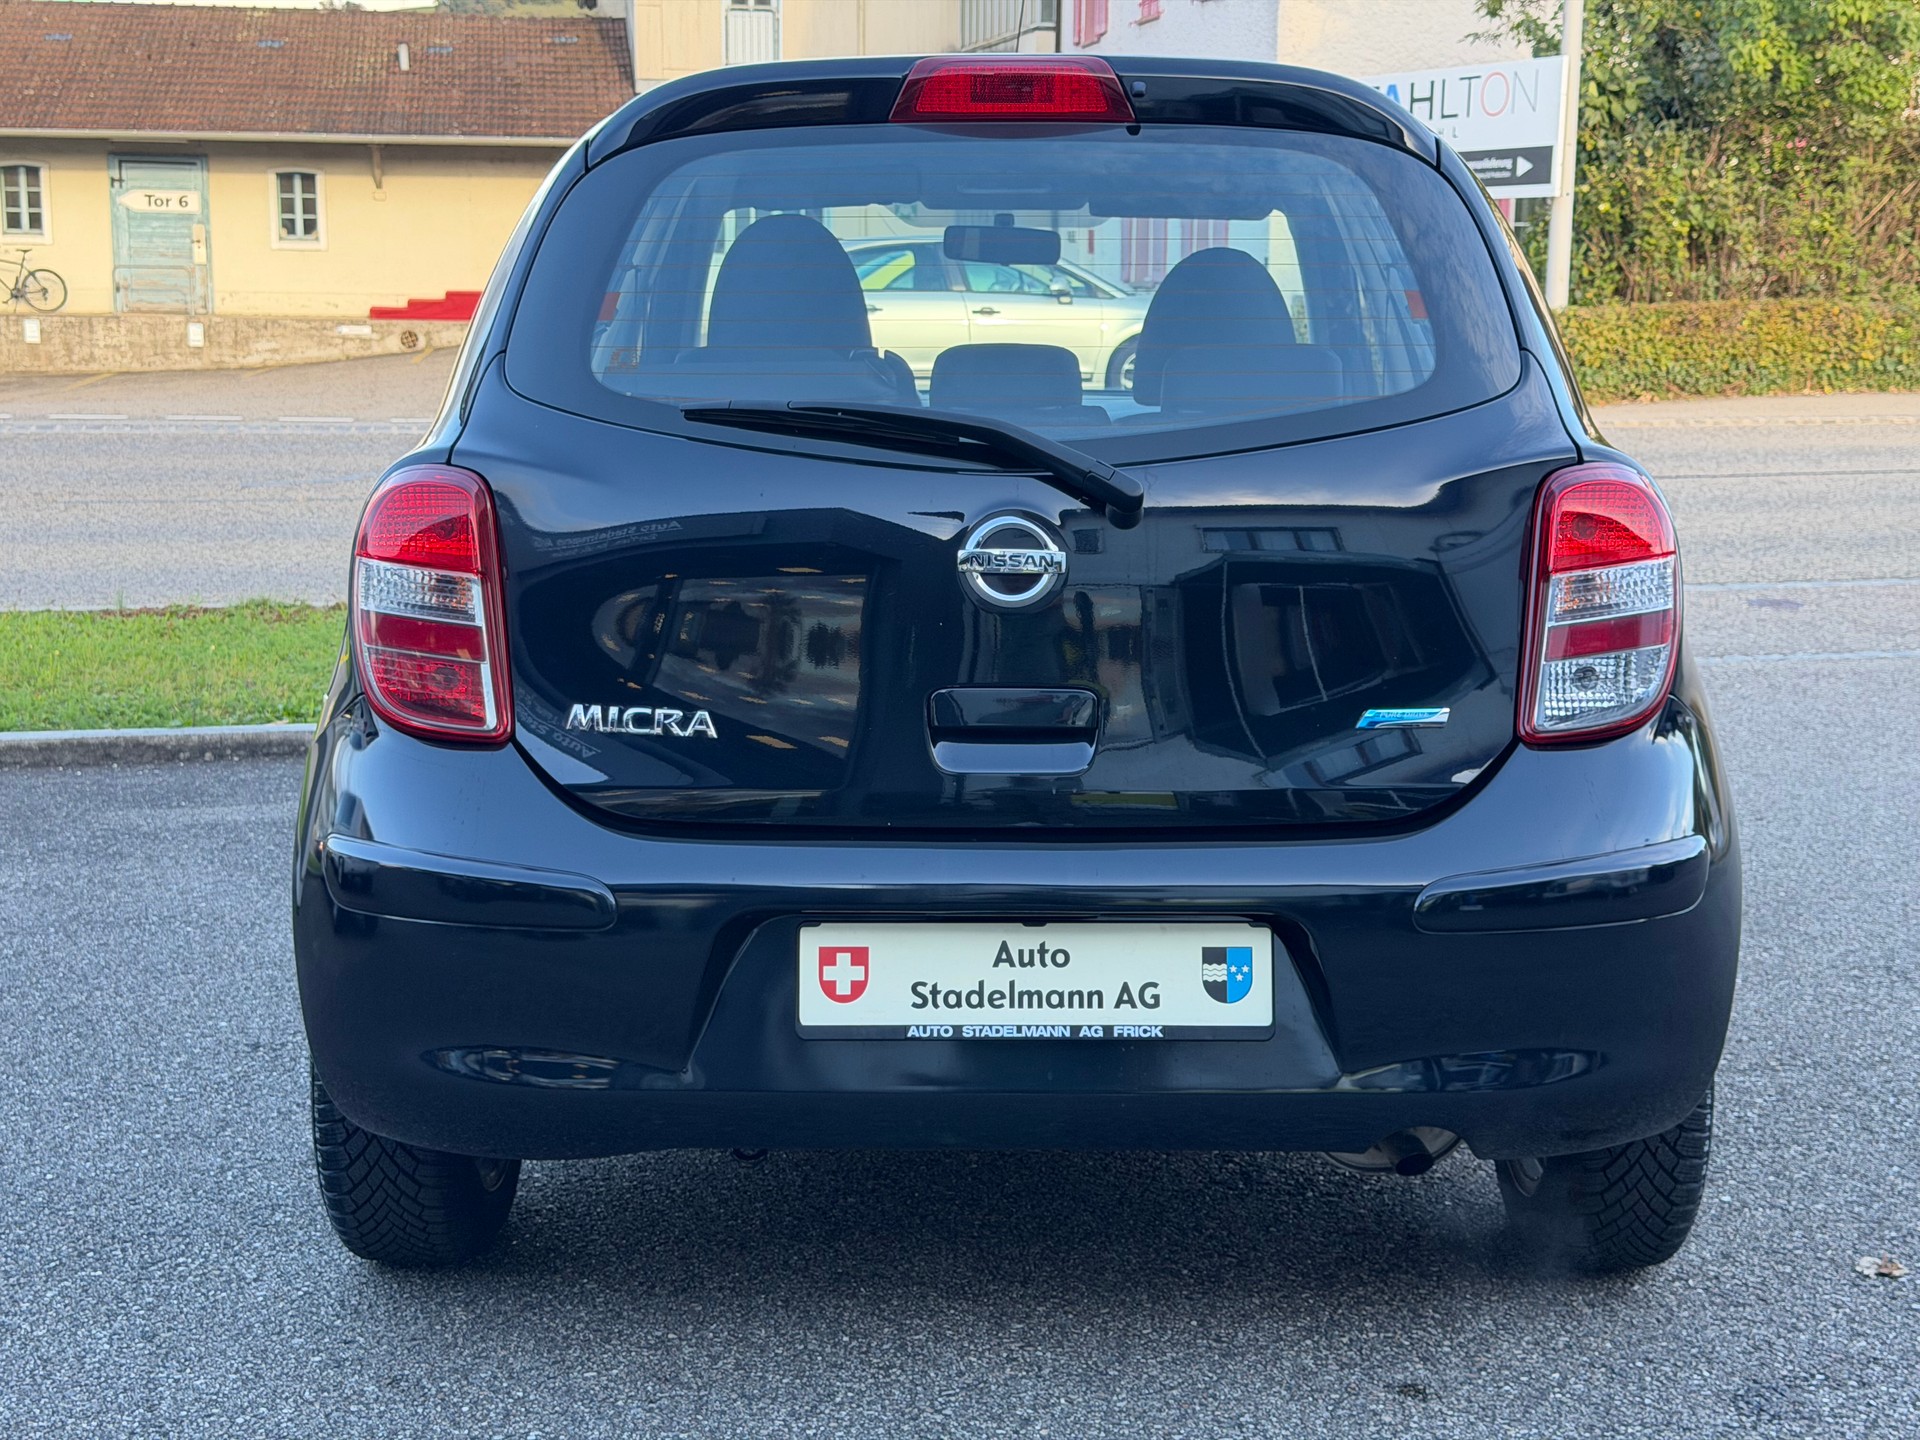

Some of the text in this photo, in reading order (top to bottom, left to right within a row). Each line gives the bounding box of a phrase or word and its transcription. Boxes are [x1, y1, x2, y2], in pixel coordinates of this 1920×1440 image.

[1374, 68, 1539, 120] AHLTON
[144, 194, 189, 208] Tor 6
[969, 553, 1054, 568] NISSAN
[566, 703, 718, 739] MICRA
[992, 940, 1071, 969] Auto
[910, 980, 1162, 1010] Stadelmann AG
[907, 1025, 1164, 1038] AUTO STADELMANN AG FRICK
